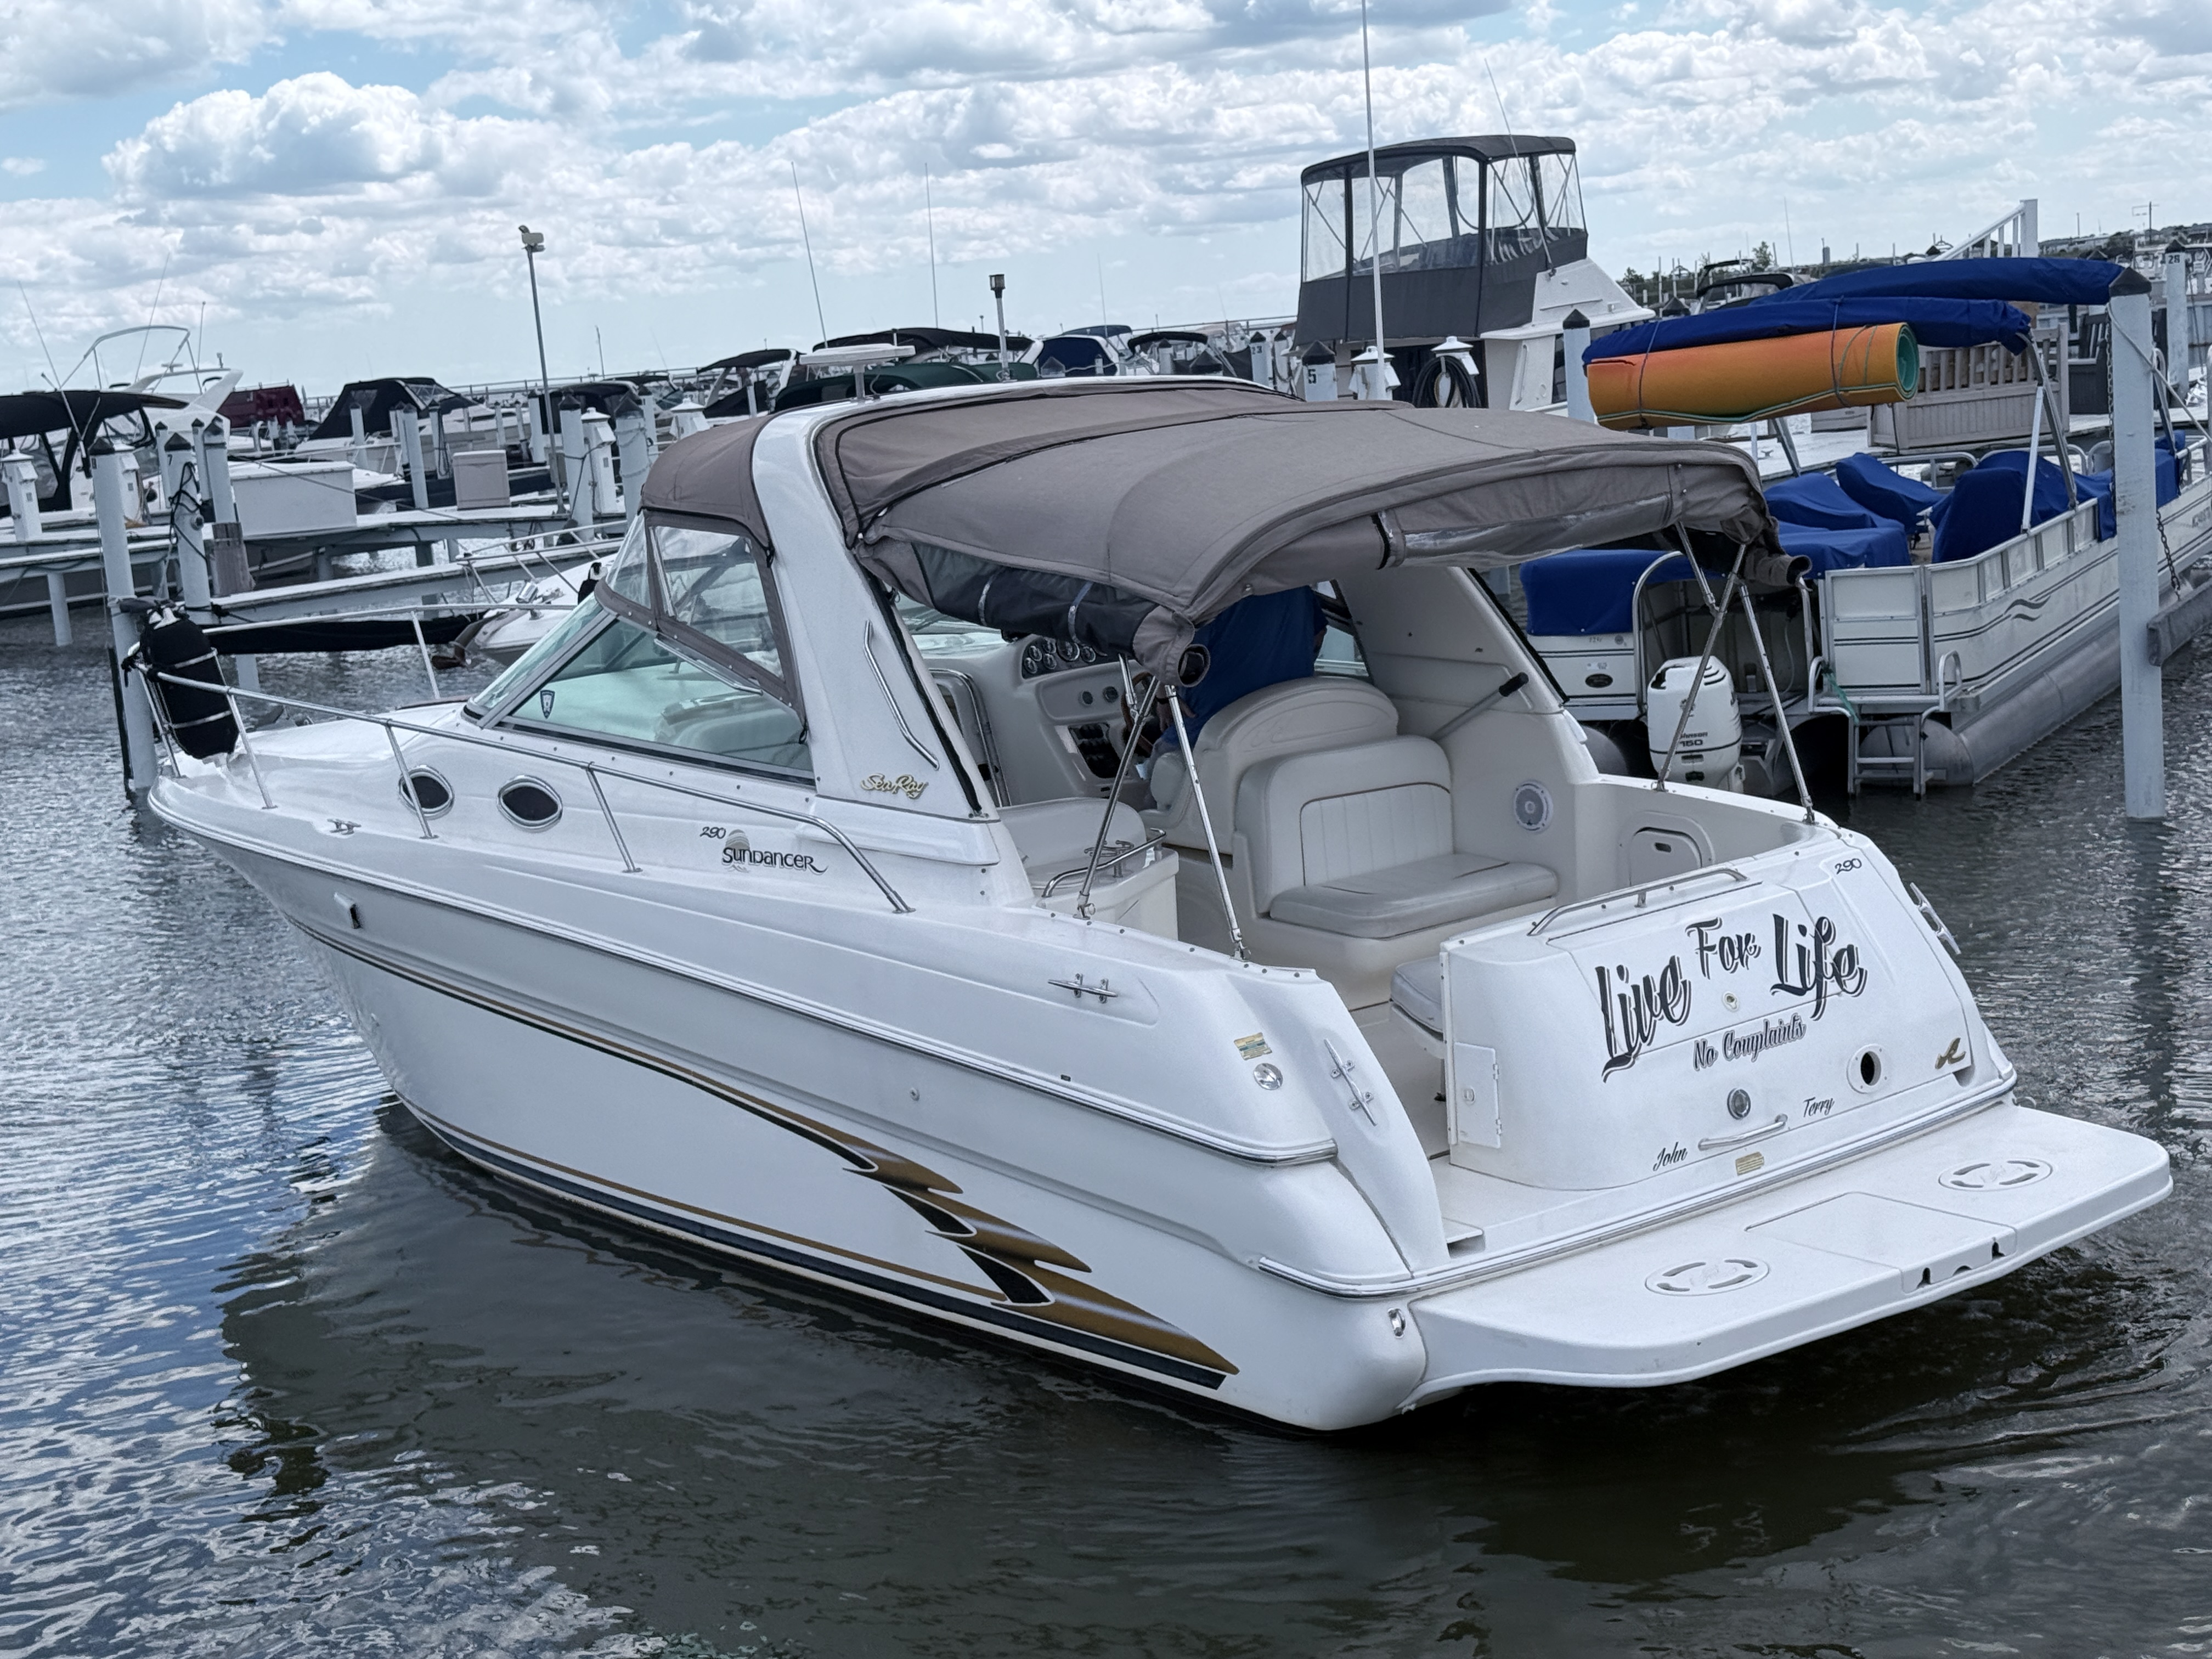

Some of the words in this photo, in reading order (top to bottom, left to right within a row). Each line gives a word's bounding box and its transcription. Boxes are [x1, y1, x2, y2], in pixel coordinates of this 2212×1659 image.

[1308, 369, 1317, 384] 5
[167, 454, 173, 466] 7
[861, 773, 895, 792] Sea
[893, 775, 929, 799] Ray
[699, 826, 726, 839] 290
[1835, 858, 1862, 875] 290
[1595, 955, 1691, 1083] Live
[1685, 917, 1762, 980] For
[1770, 913, 1867, 1020] Life
[1693, 1039, 1718, 1071] No
[1722, 1013, 1807, 1062] Complaints
[1803, 1097, 1835, 1118] Terry
[1653, 1142, 1688, 1171] John
